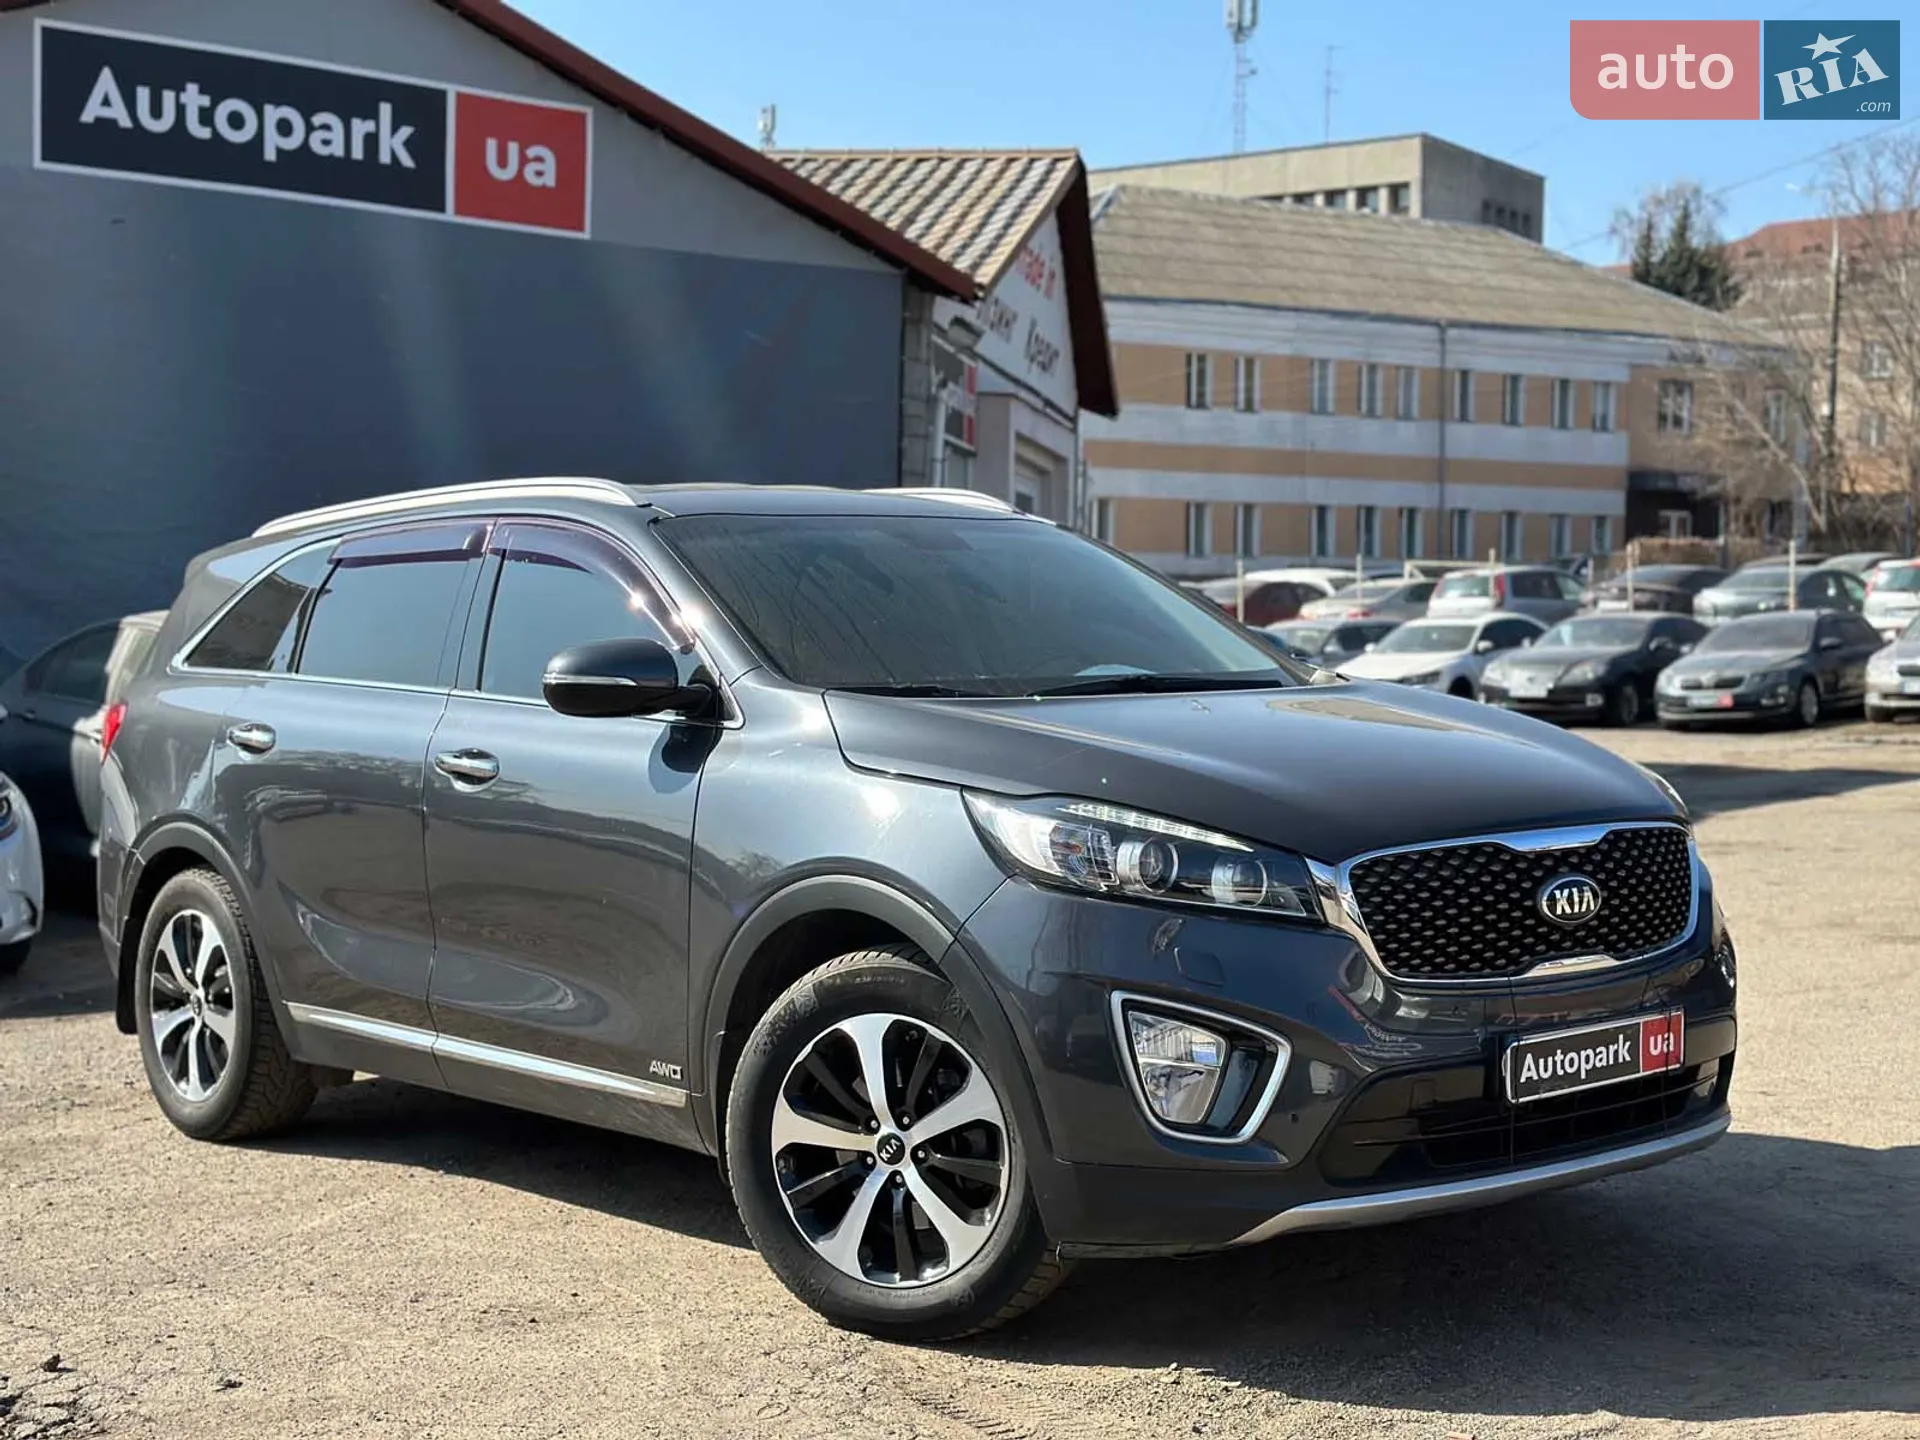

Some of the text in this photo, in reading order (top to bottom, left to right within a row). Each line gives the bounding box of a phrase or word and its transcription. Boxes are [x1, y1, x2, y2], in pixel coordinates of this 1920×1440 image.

[80, 66, 557, 188] Autopark ua
[1553, 886, 1595, 915] KIA
[650, 1060, 682, 1080] AWD
[1520, 1032, 1674, 1083] Autopark ua
[880, 1139, 901, 1161] KIA
